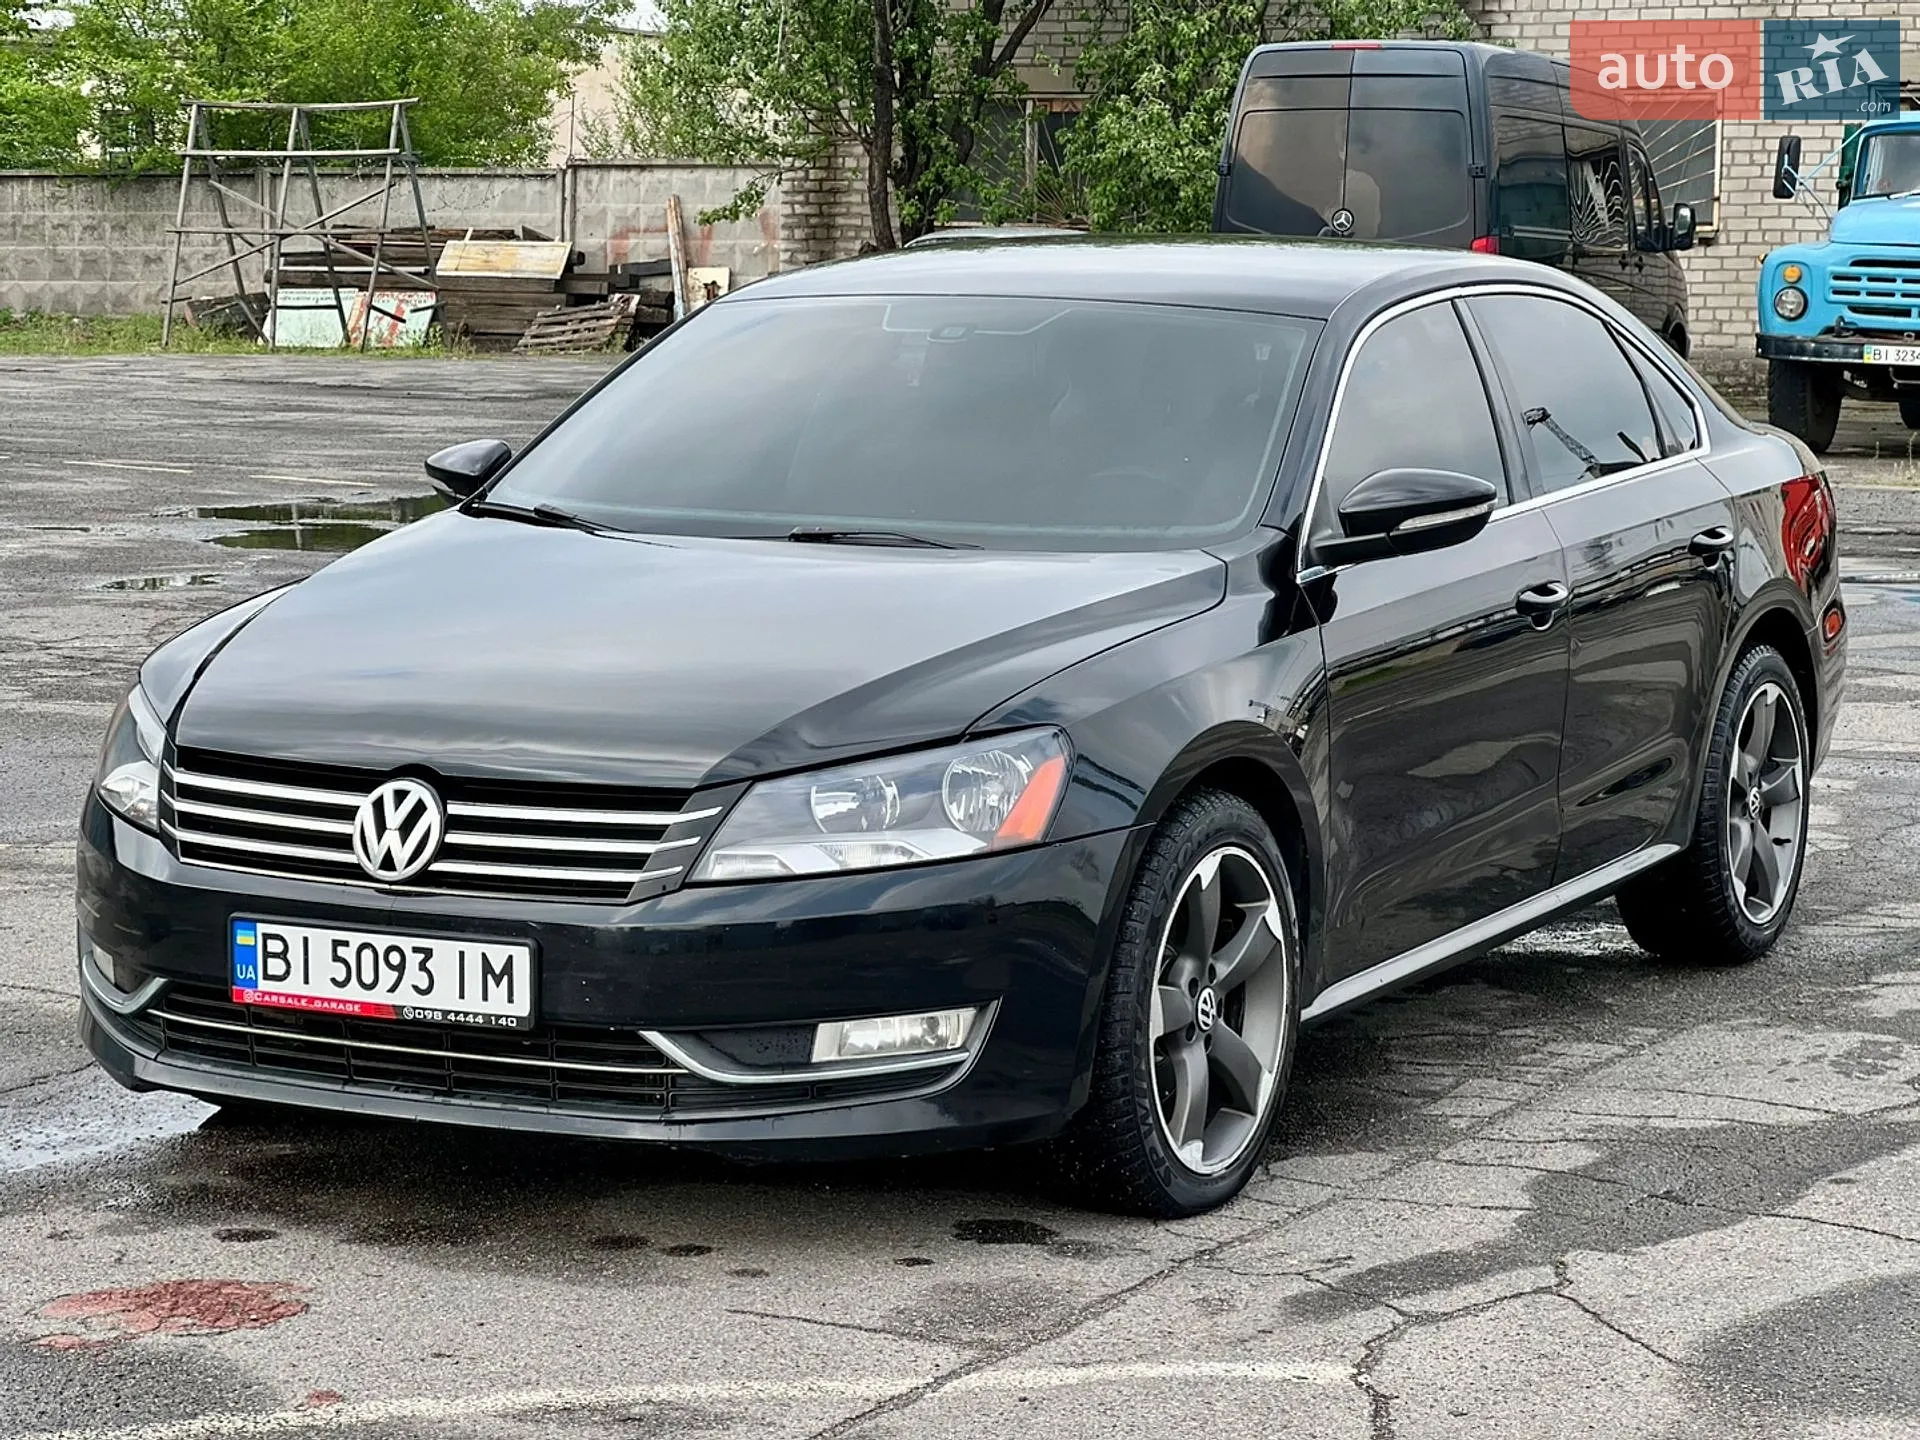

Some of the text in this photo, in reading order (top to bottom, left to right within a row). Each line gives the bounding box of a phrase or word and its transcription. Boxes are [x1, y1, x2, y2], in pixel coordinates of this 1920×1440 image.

[1873, 349, 1888, 361] BI
[236, 963, 256, 980] UA
[262, 933, 515, 1004] BI 5093 IM
[415, 1009, 517, 1027] 098 4444 140
